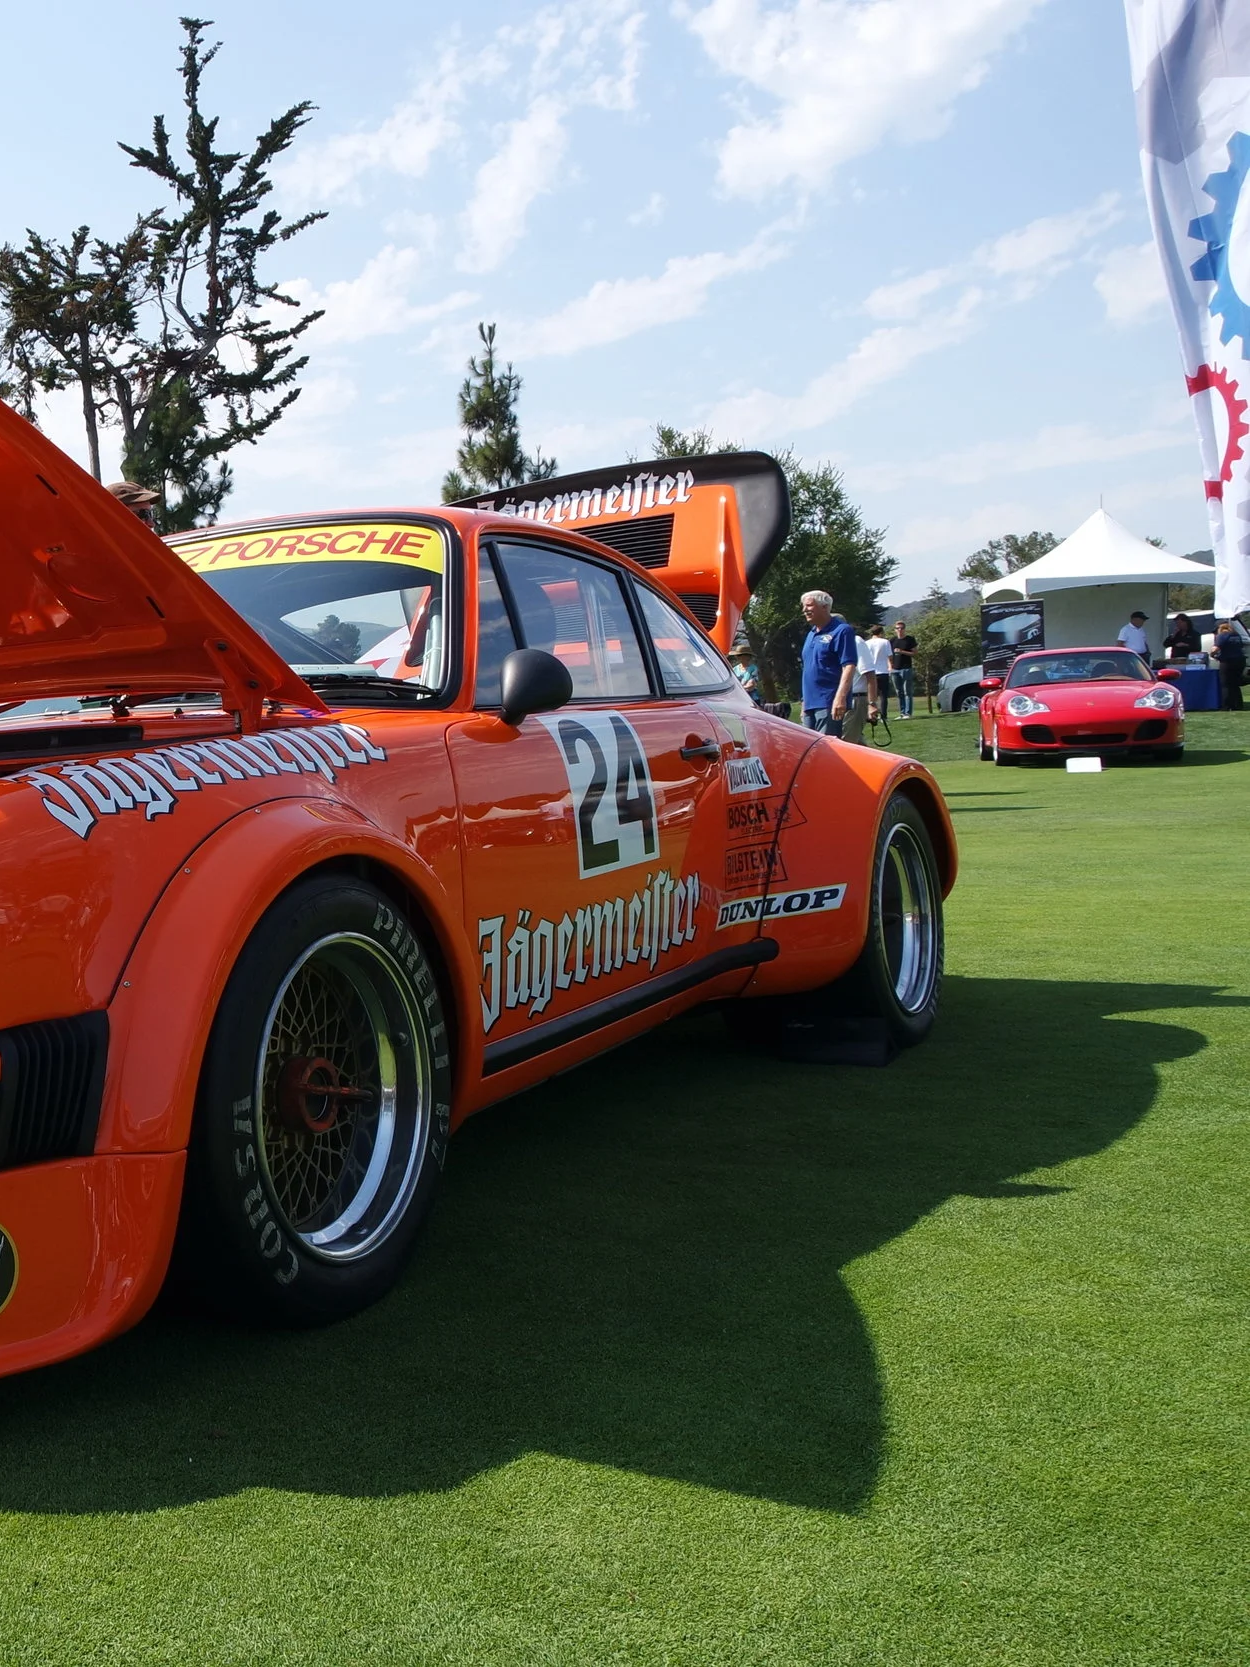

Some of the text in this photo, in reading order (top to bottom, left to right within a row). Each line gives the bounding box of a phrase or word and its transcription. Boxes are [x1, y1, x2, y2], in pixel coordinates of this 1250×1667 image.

[477, 469, 695, 524] ägermeister
[209, 531, 432, 565] PORSCHE
[558, 716, 655, 871] 24
[726, 759, 770, 792] VALVOLINE
[728, 801, 770, 830] BOSCH
[727, 847, 778, 876] BILSTEIN
[718, 887, 839, 927] DUNLOP
[478, 867, 700, 1034] Jägermeister
[372, 901, 451, 1071] PIRELLI
[231, 1094, 301, 1286] CORSA
